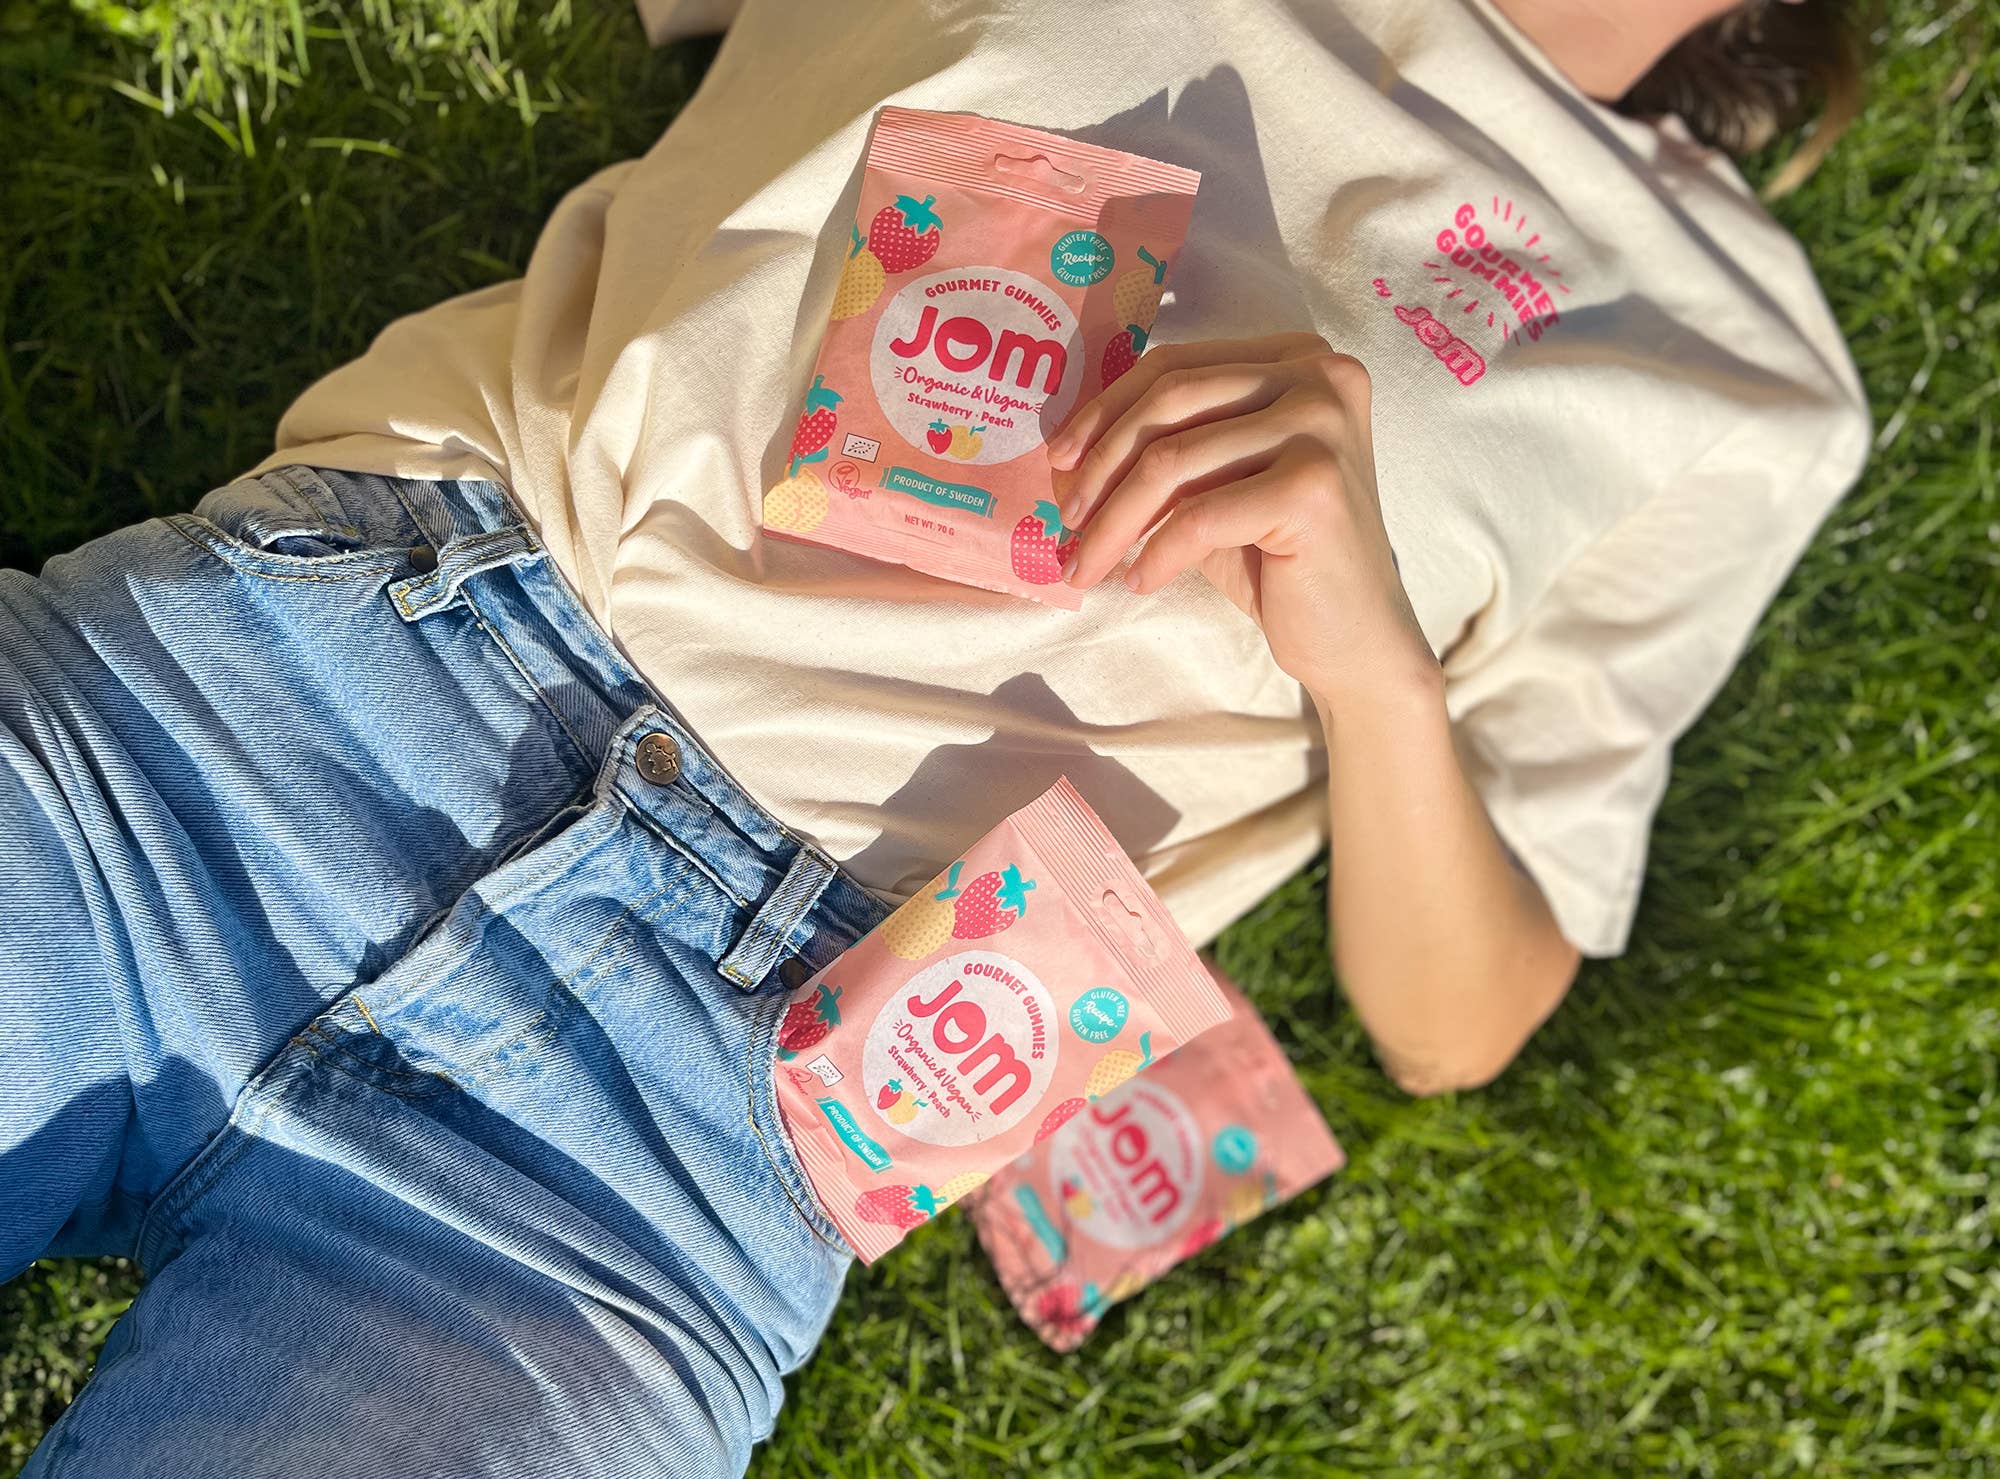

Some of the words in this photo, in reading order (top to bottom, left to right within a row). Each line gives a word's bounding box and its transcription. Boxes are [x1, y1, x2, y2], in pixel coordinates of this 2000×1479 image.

[1058, 234, 1087, 251] GLUTEN
[1090, 236, 1108, 252] FREE
[1061, 252, 1105, 266] Recipe
[1057, 267, 1086, 284] GLUTEN
[1088, 265, 1107, 282] FREE
[1455, 203, 1560, 328] GOURMET
[1436, 228, 1543, 342] GUMMIES
[925, 279, 1001, 298] GOURMET
[1004, 285, 1062, 331] GUMMIES
[903, 367, 970, 396] Organic
[971, 385, 983, 399] &
[985, 386, 1033, 412] Vegan
[907, 392, 972, 419] Strawberry
[981, 411, 1014, 428] Peach
[893, 474, 934, 493] PRODUCT
[935, 486, 947, 497] OF
[948, 489, 985, 508] SWEDEN
[904, 514, 920, 526] NET
[937, 523, 947, 534] 70
[963, 963, 1028, 996] GOURMET
[1022, 995, 1046, 1060] GUMMIES
[897, 1023, 937, 1071] Organic
[1089, 1029, 1109, 1040] FREE
[888, 1045, 927, 1092] Strawberry
[927, 1090, 950, 1119] Peach
[936, 1068, 946, 1081] &
[940, 1074, 974, 1115] Vegan
[827, 1105, 856, 1135] PRODUCT
